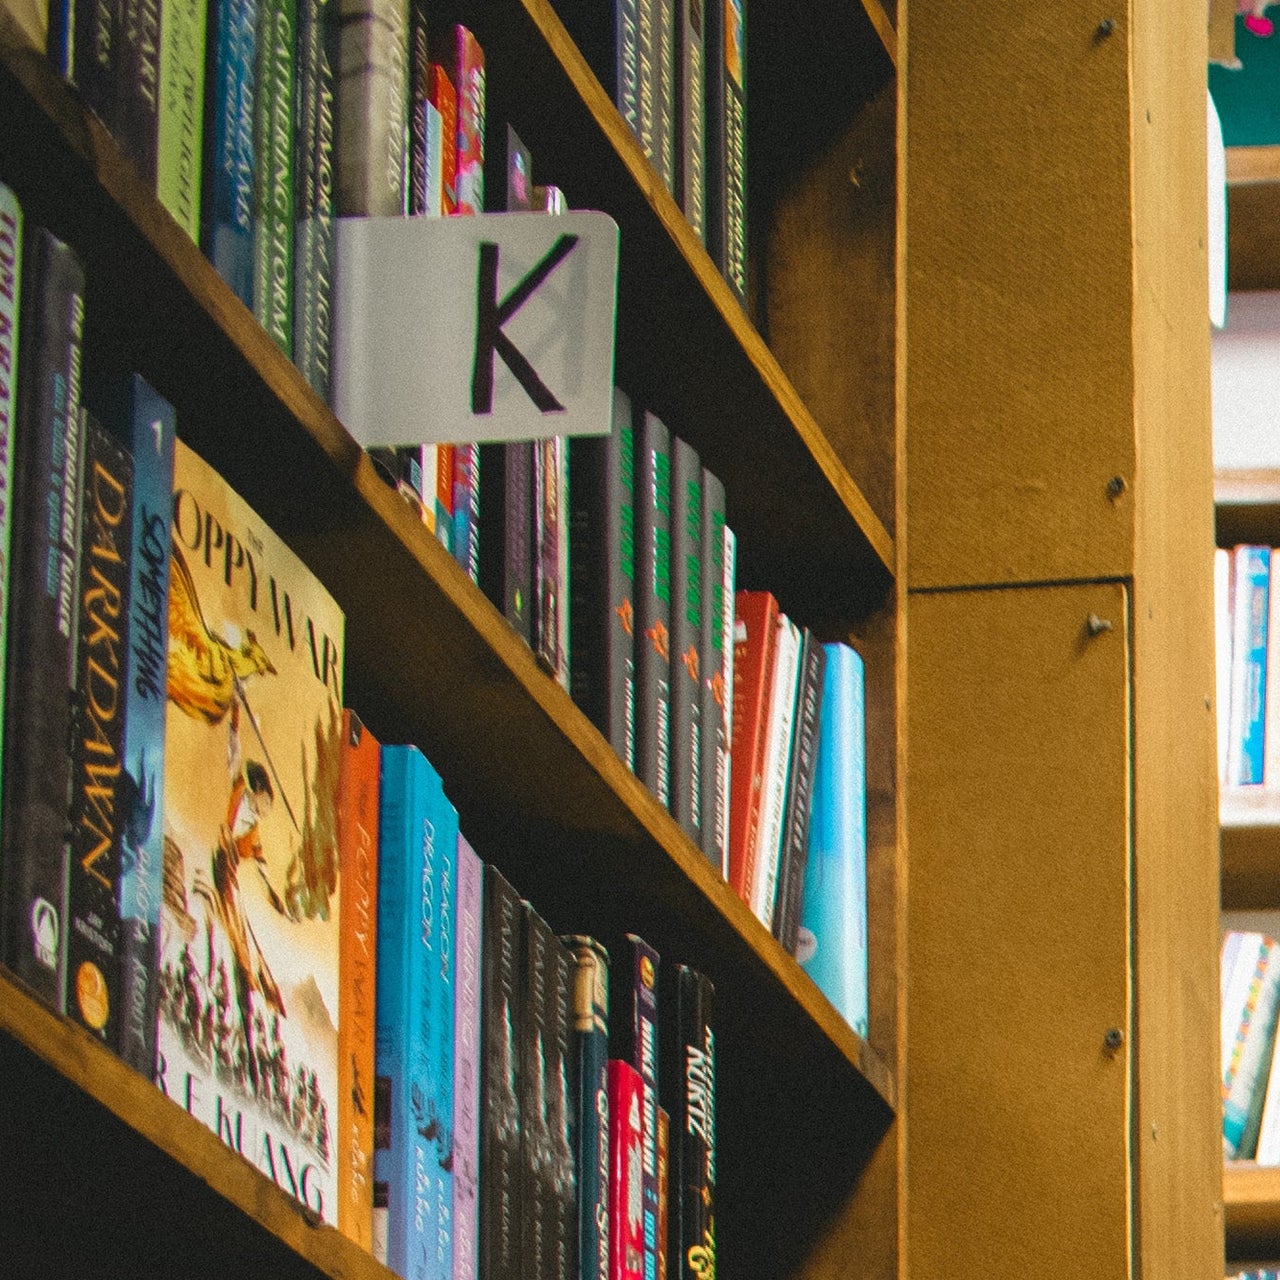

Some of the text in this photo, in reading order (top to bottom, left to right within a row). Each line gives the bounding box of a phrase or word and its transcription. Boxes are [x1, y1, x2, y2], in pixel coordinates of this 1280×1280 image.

[234, 78, 256, 238] DREAMS
[269, 4, 292, 347] GATHERING STORM
[316, 77, 333, 242] MEMORY
[314, 270, 330, 391] LIGHT
[471, 232, 579, 416] K
[57, 290, 84, 644] the unincorporated future
[151, 418, 165, 458] 1
[131, 491, 168, 721] SOMETHING
[172, 486, 343, 702] OPPY WAR
[80, 453, 125, 904] DARKDAWN
[624, 674, 634, 773] KINGFISH
[799, 681, 817, 768] HOLLOW
[420, 817, 436, 951] DRAGON
[439, 852, 451, 986] DRAGON
[460, 907, 476, 1049] BURNING
[593, 1085, 608, 1183] QUEST
[684, 1044, 704, 1136] KURTZ
[413, 1145, 425, 1234] KUANG
